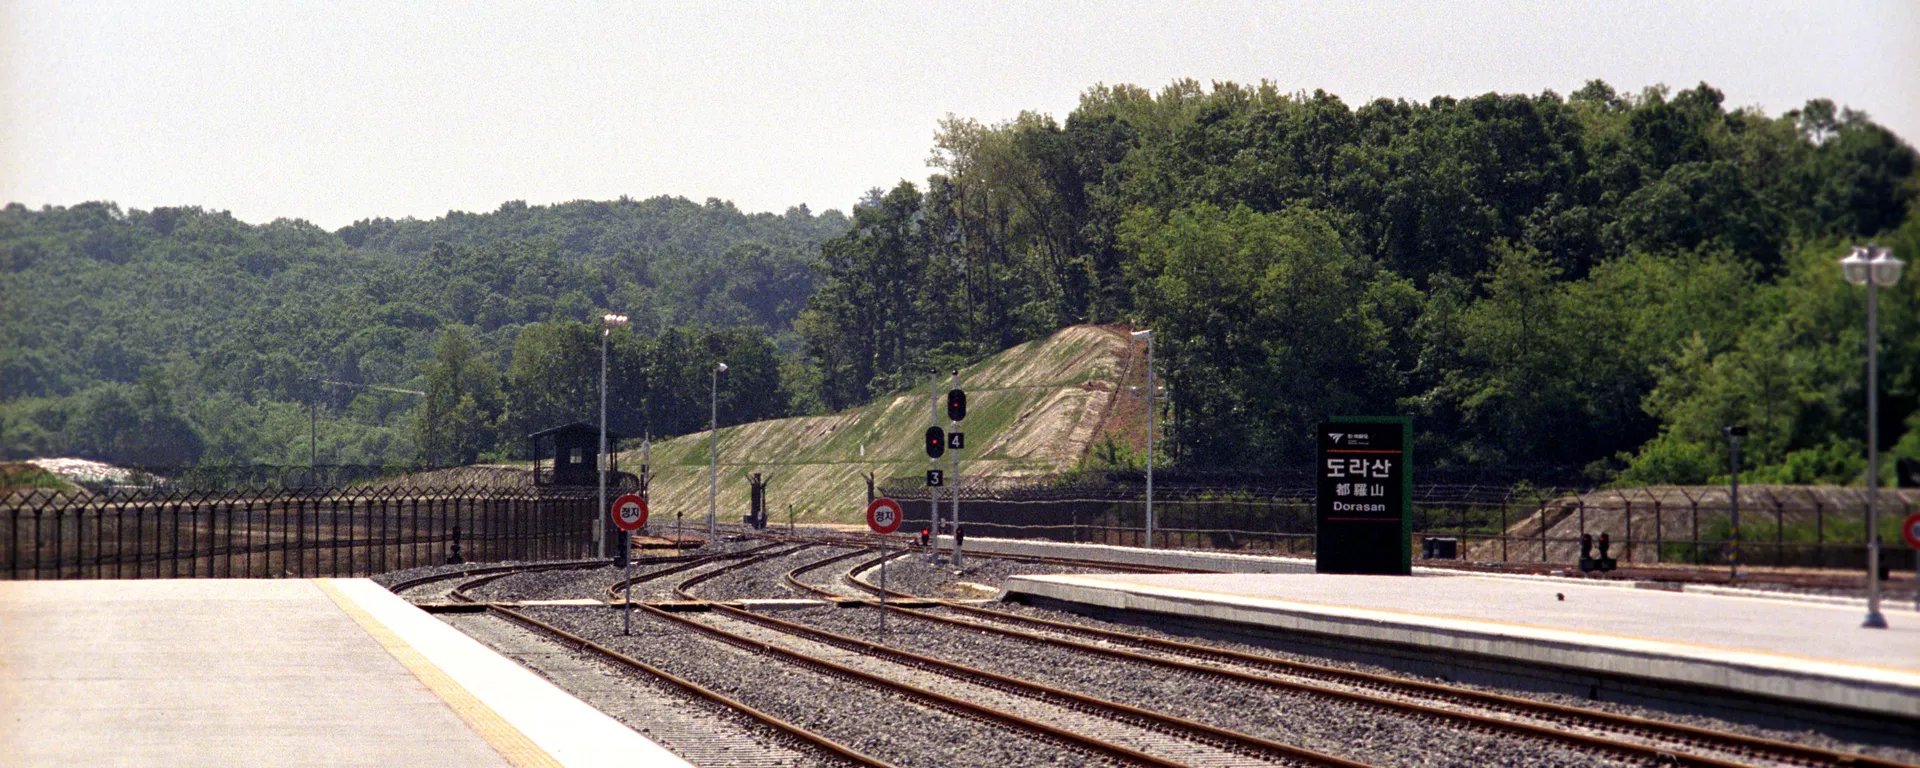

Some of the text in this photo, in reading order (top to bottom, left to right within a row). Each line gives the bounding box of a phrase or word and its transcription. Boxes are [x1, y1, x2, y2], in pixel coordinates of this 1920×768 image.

[951, 435, 960, 448] 4
[1327, 459, 1392, 477] 도라산
[931, 472, 939, 485] 3
[1336, 483, 1384, 496] 都羅山
[621, 507, 640, 518] 정지
[1333, 501, 1385, 511] Dorasan
[875, 511, 894, 522] 정지
